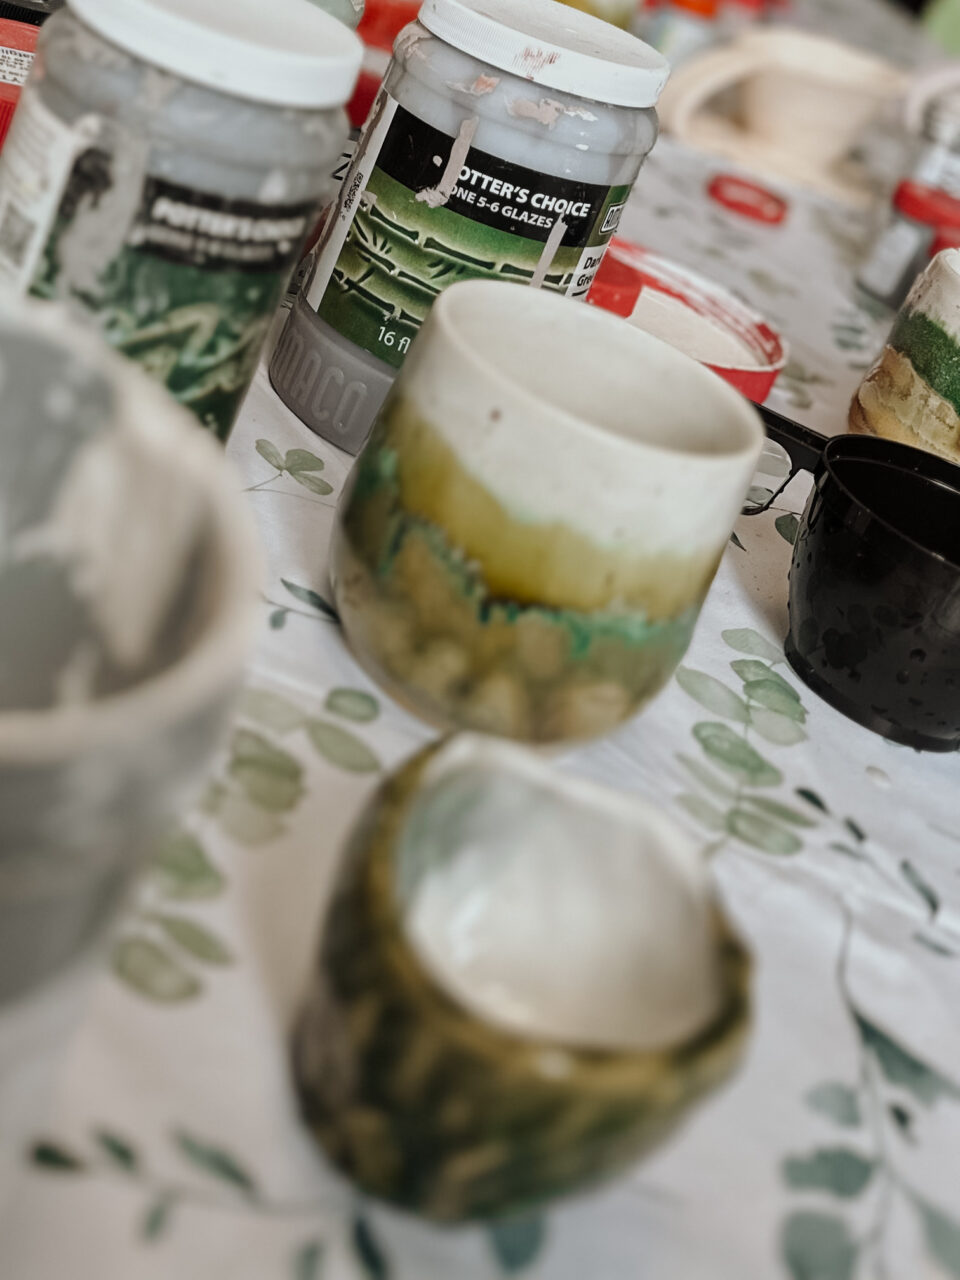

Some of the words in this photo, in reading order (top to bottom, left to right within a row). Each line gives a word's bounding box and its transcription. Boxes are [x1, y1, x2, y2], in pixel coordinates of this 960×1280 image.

[451, 184, 477, 205] ONE
[477, 196, 501, 213] 5-6
[501, 205, 553, 229] GLAZES
[458, 165, 530, 204] OTTER'S
[530, 193, 591, 218] CHOICE
[583, 255, 602, 270] Dar
[378, 325, 396, 346] 16
